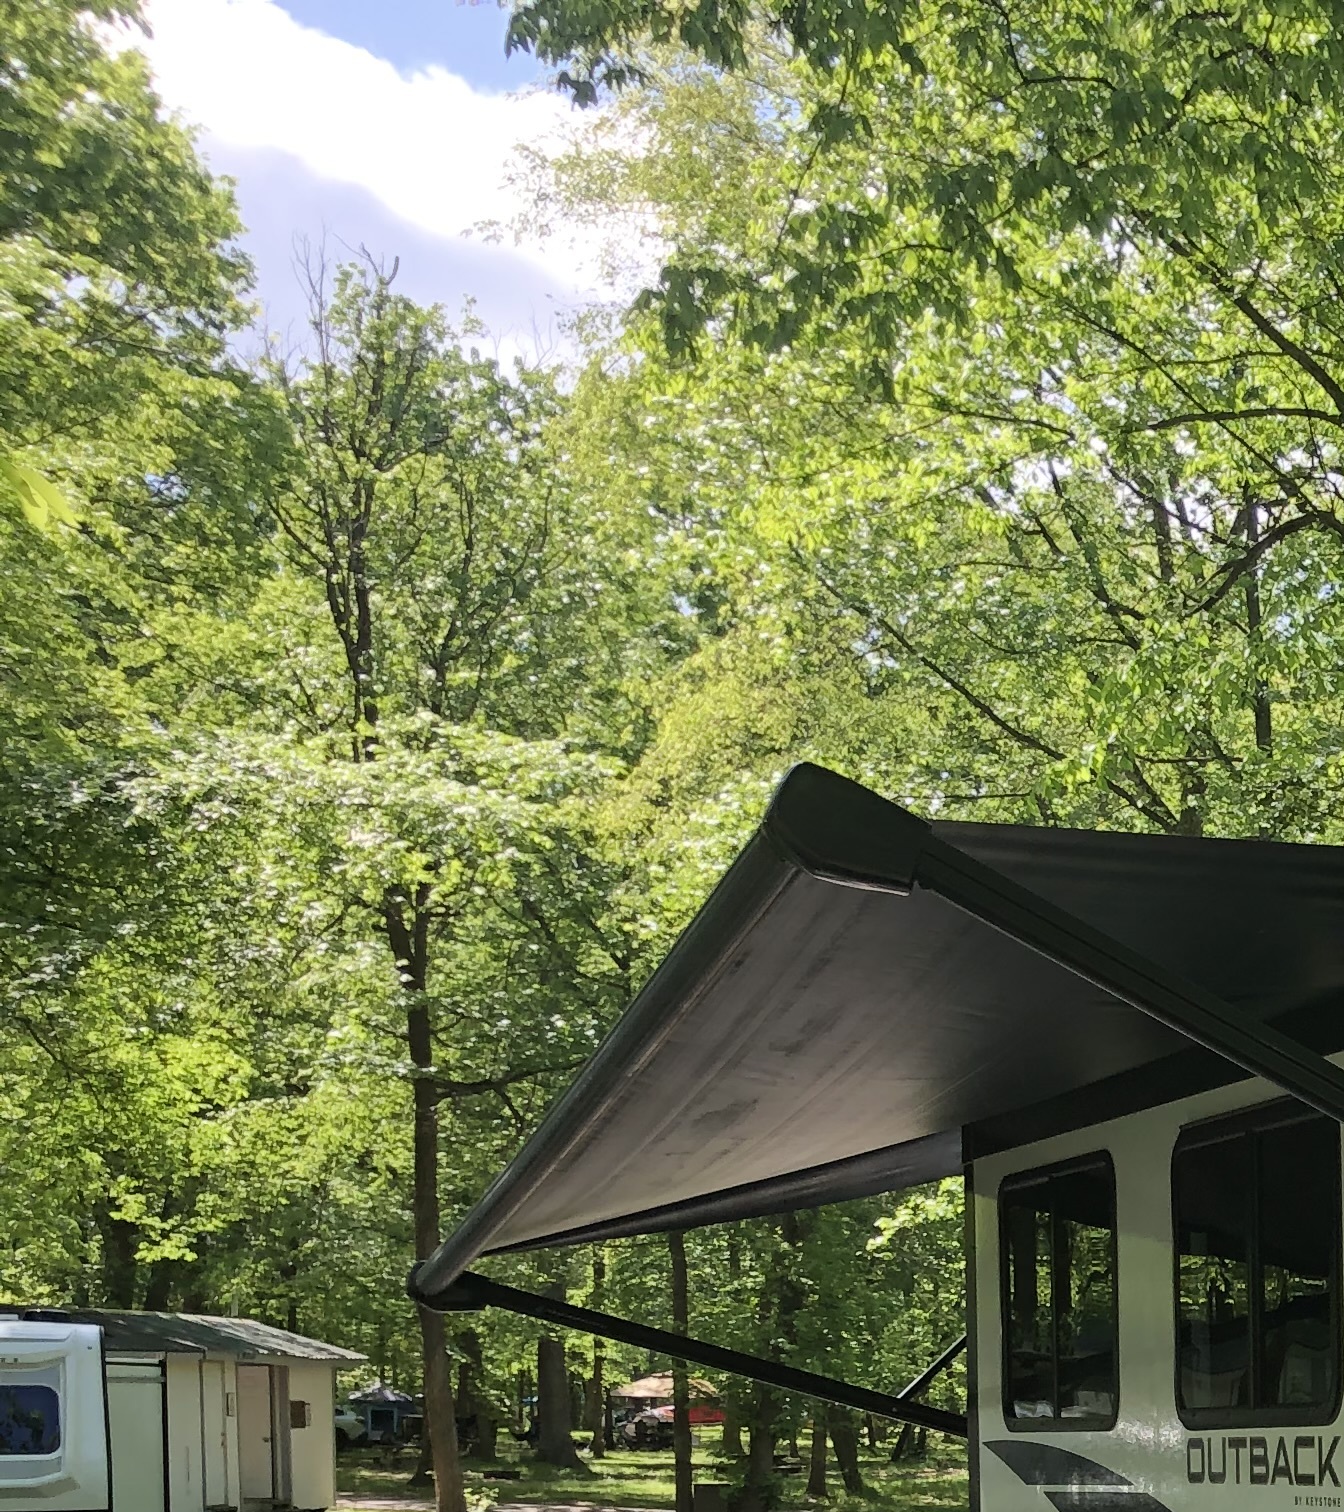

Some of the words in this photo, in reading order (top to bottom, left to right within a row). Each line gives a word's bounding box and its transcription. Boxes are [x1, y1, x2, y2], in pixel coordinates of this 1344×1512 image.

[1187, 1436, 1341, 1487] OUTBACK
[1294, 1496, 1303, 1506] BY
[1305, 1496, 1341, 1508] KEYSTONE
